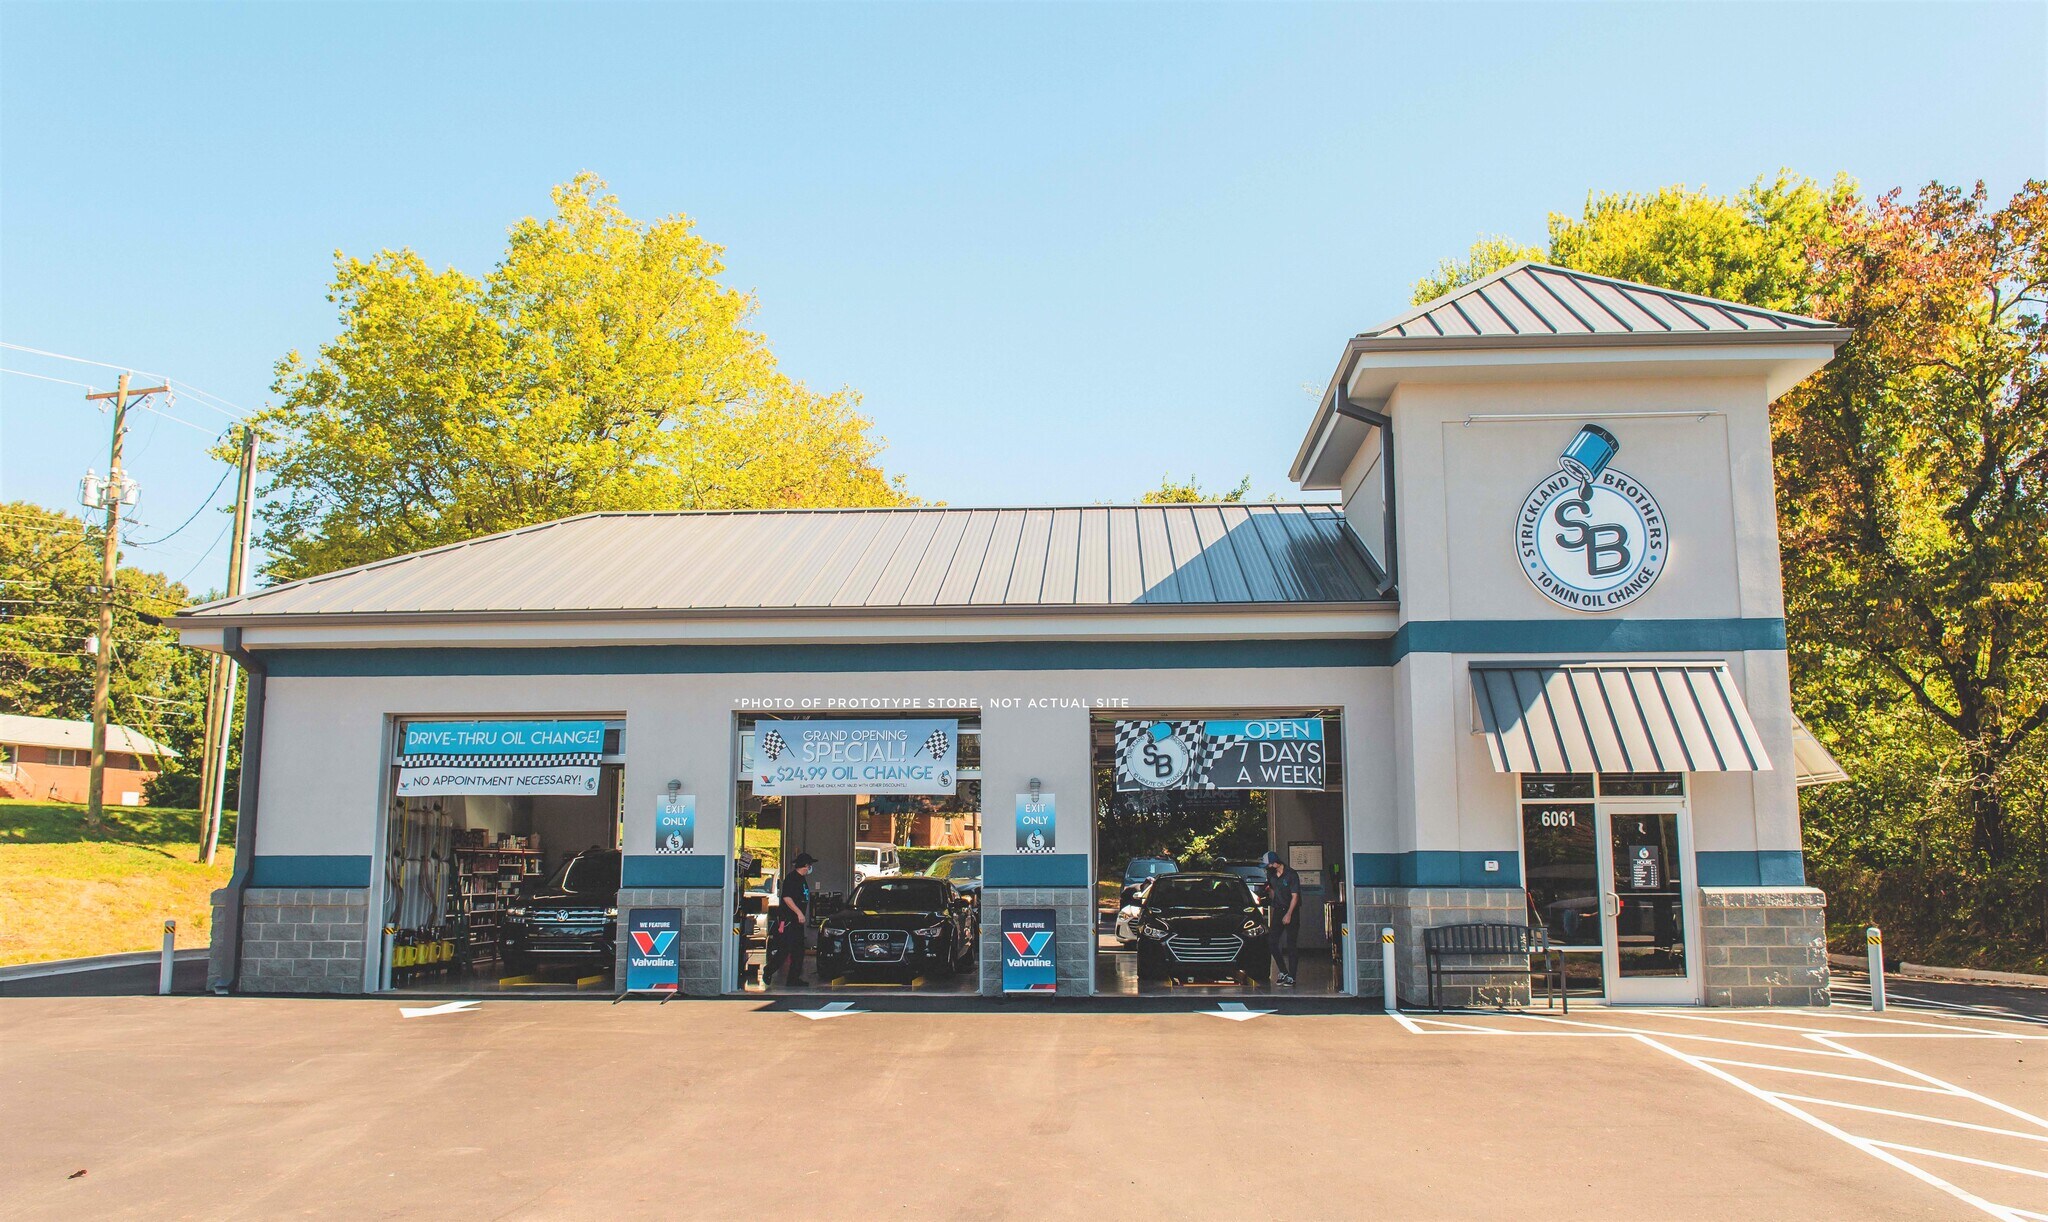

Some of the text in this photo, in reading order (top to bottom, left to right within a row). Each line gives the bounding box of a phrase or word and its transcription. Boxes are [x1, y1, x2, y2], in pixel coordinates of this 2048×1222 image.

[1521, 473, 1662, 558] STRICKLAND BROTHERS
[1538, 566, 1655, 607] 10 MIN OIL CHANGE
[408, 729, 600, 746] DRIVE-THRU OIL CHANGE!
[802, 729, 908, 741] GRAND OPENING
[1245, 721, 1310, 739] OPEN
[802, 741, 907, 763] SPECIAL!
[1234, 742, 1321, 763] 7 DAYS
[413, 775, 582, 786] NO APPOINTMENT NECESSARY!
[776, 765, 934, 782] $24.99 OIL CHANGE
[1236, 765, 1323, 786] A WEEK!
[665, 805, 686, 814] EXIT
[1025, 803, 1046, 813] EXIT
[662, 817, 688, 826] ONLY
[1022, 815, 1049, 825] ONLY
[1541, 811, 1576, 827] 6061
